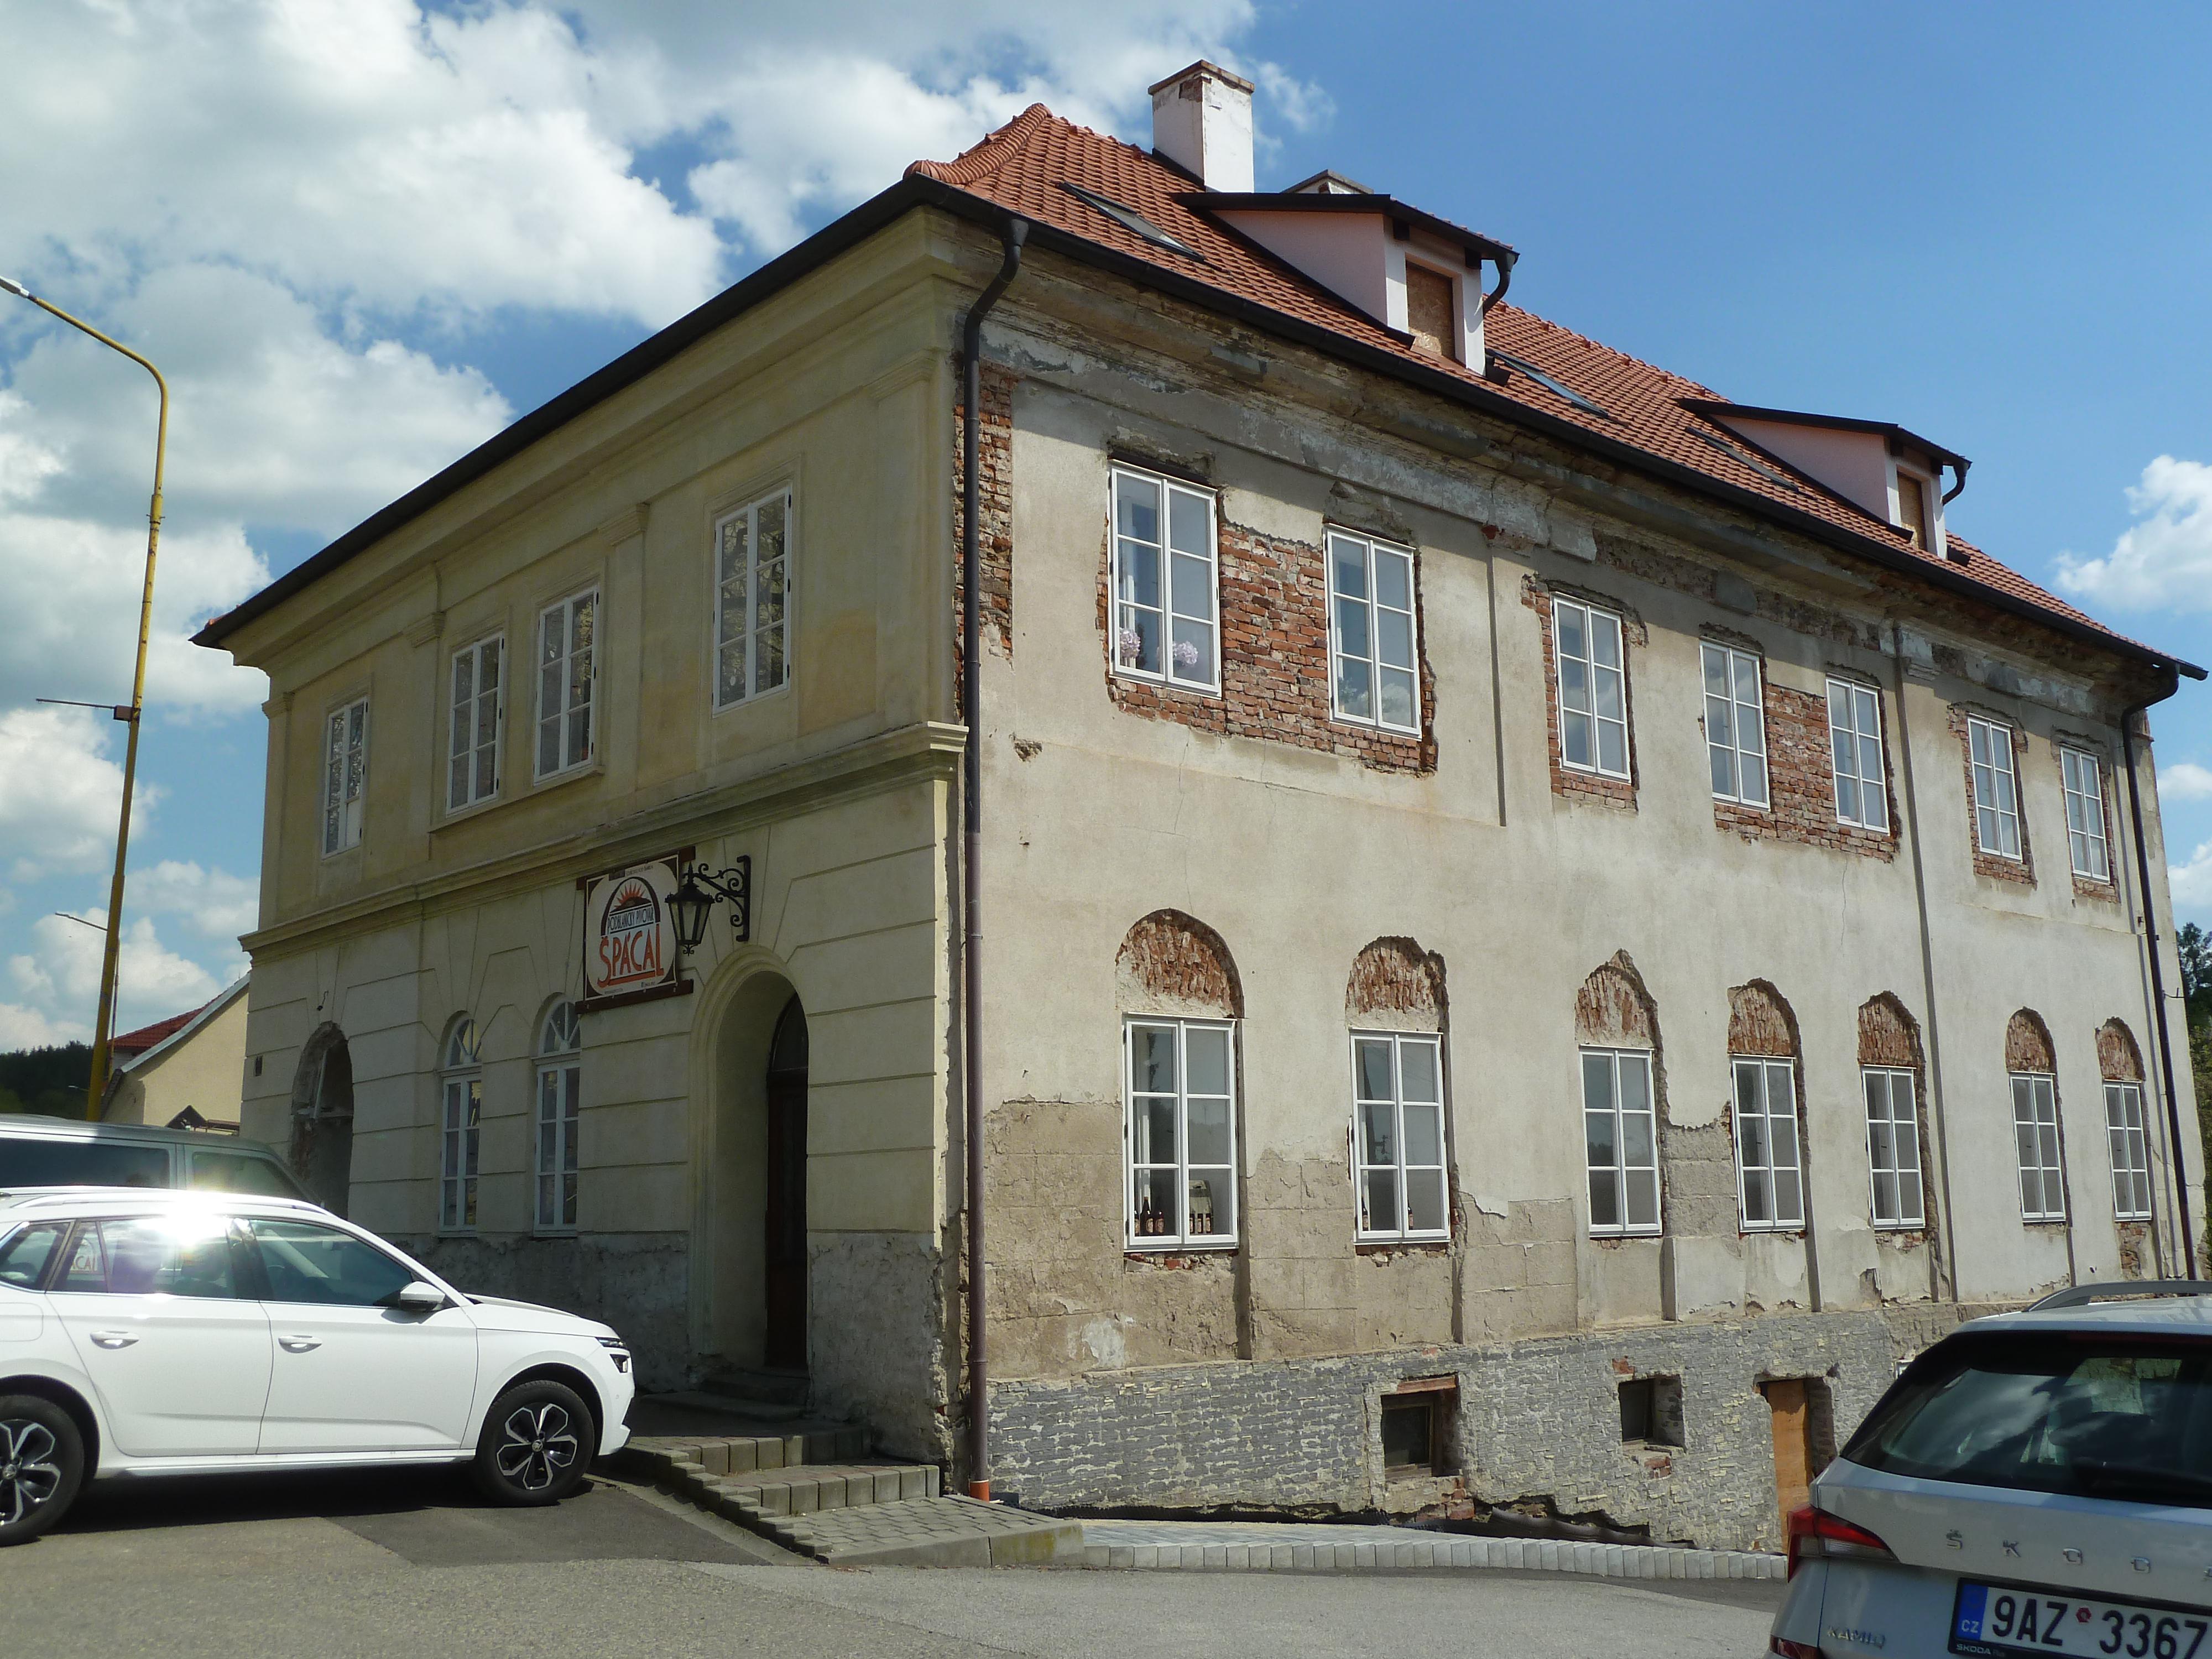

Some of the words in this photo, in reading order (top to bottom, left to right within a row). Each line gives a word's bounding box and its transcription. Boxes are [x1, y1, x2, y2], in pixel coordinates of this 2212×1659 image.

[1961, 1619, 1980, 1634] CZ
[1992, 1595, 2068, 1647] 9AZ
[2099, 1609, 2208, 1659] 3367
